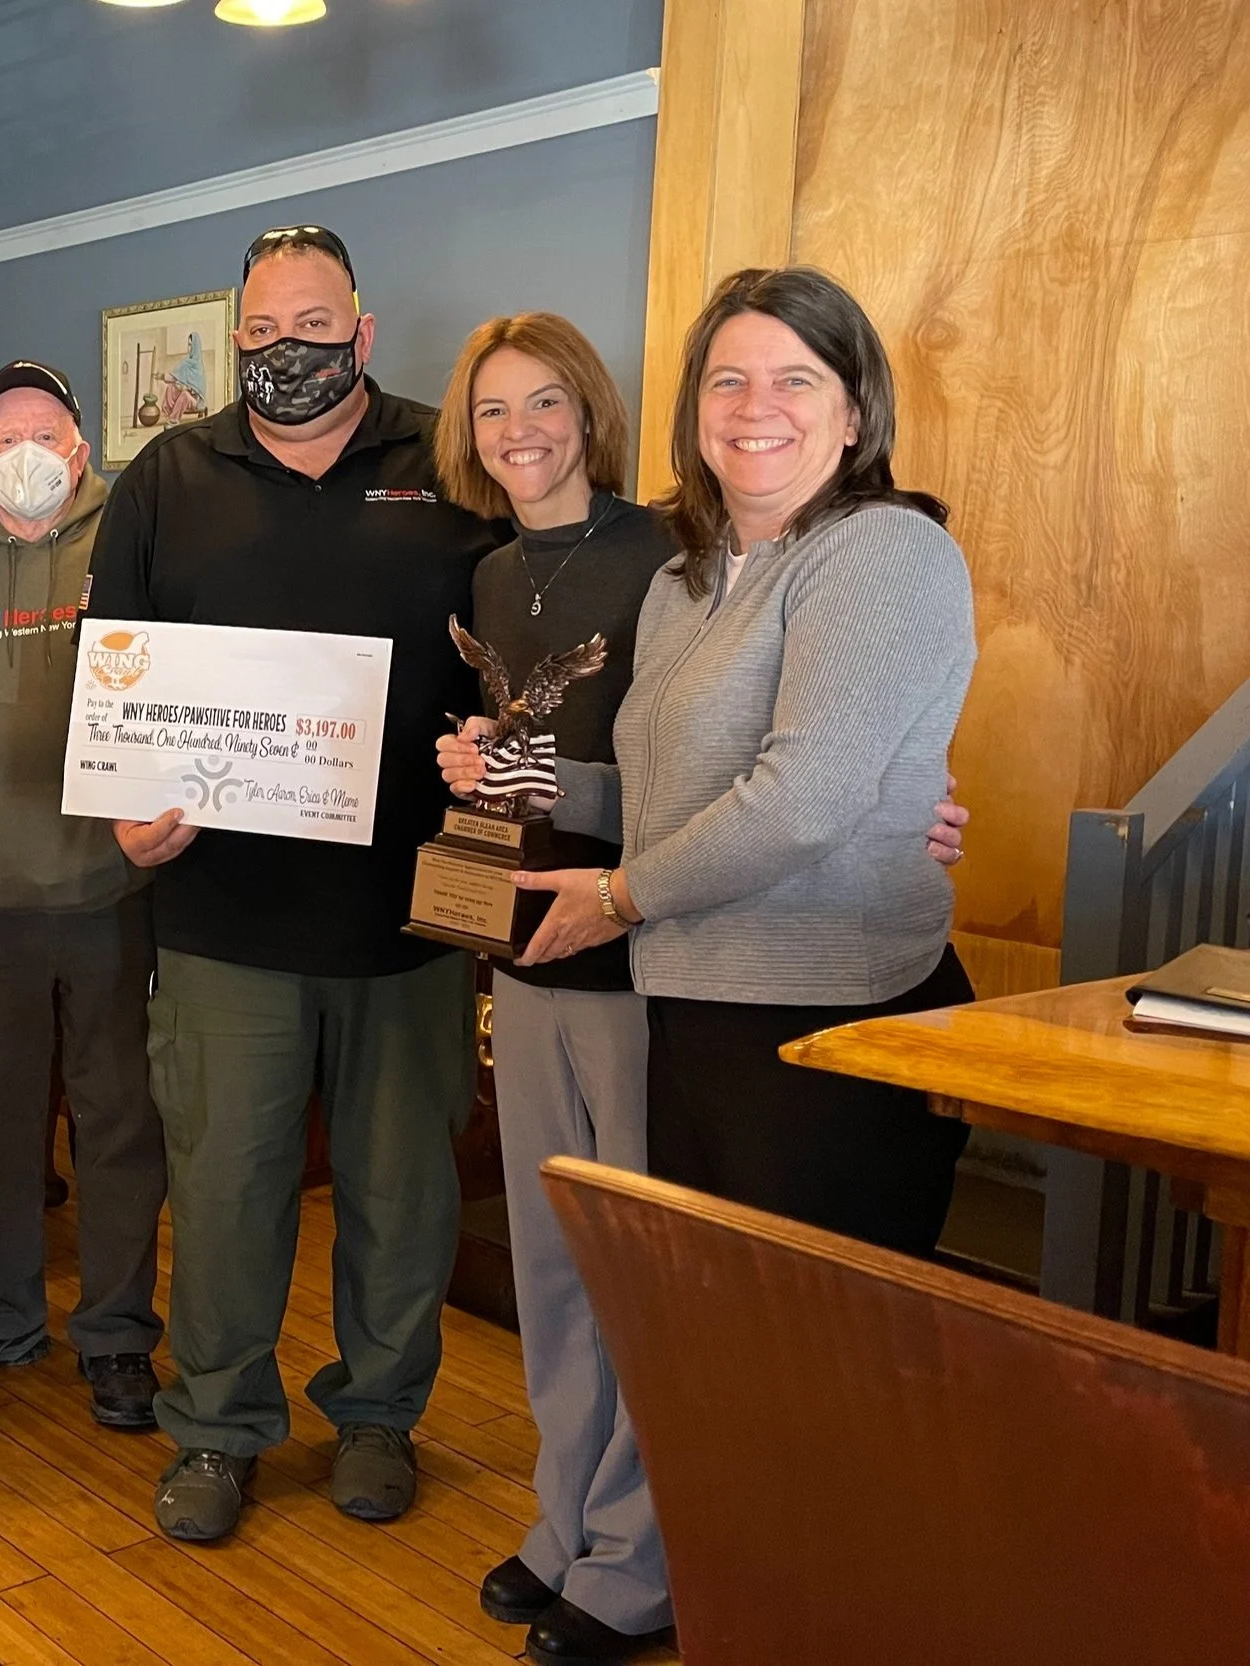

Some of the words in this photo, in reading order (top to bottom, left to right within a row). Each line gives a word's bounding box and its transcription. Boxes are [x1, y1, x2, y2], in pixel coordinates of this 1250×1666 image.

[87, 652, 151, 671] WING
[87, 698, 97, 709] Pay
[98, 700, 105, 708] to
[105, 699, 114, 708] the
[85, 713, 100, 721] order
[101, 713, 108, 722] of
[122, 702, 145, 720] WNY
[146, 703, 231, 728] HEROES/PAWSITIVE
[232, 709, 251, 729] FOR
[252, 711, 287, 732] HEROES
[295, 718, 356, 740] $3,197.00
[88, 723, 110, 742] Three
[157, 728, 175, 747] One
[225, 733, 258, 759] Ninety
[259, 736, 289, 758] Seven
[306, 740, 317, 751] 00
[80, 760, 96, 770] WING
[97, 761, 117, 772] CRAWL
[304, 755, 316, 764] 00
[319, 757, 354, 768] Dollars
[299, 785, 320, 804] Erica
[300, 810, 319, 819] EVENT
[320, 812, 356, 822] COMMITTEE
